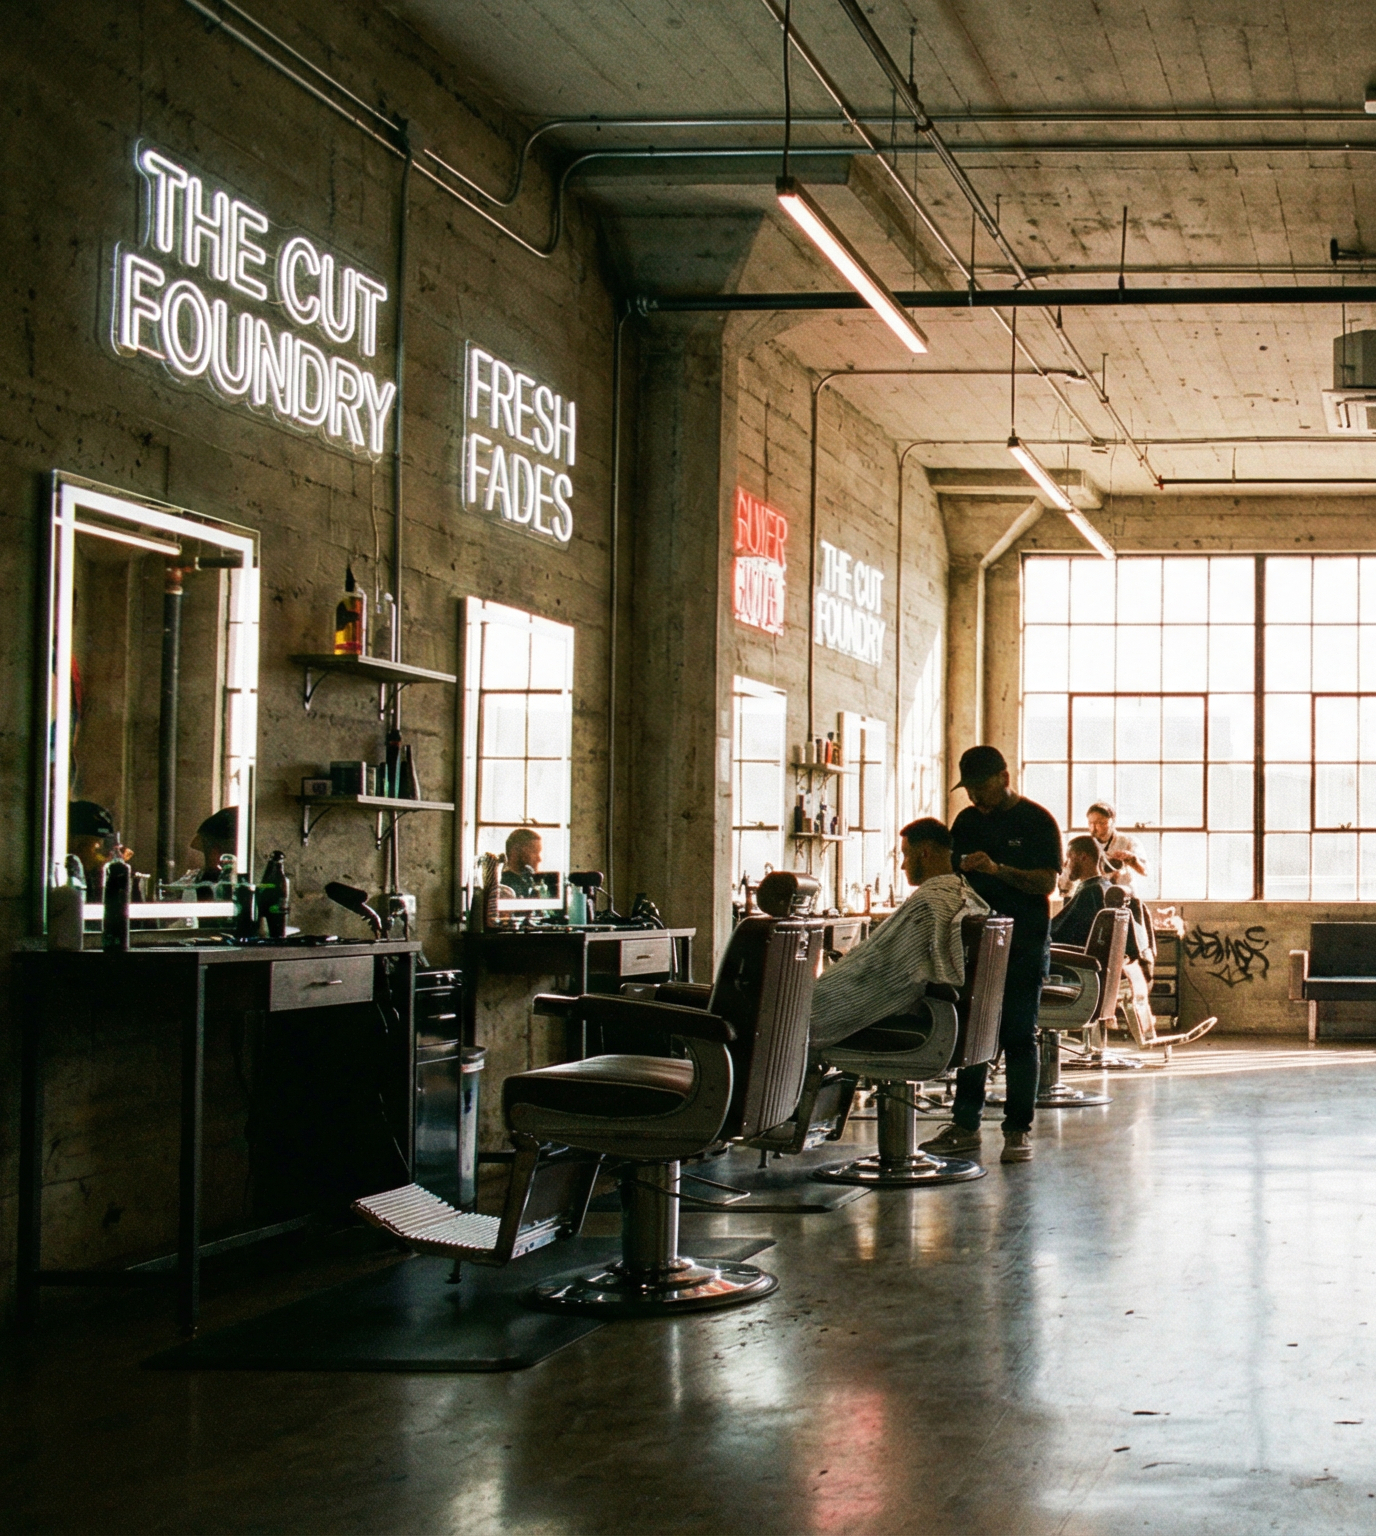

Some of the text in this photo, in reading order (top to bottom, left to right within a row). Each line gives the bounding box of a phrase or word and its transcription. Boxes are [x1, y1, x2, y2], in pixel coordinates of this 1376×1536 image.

[141, 149, 388, 357] THE CUT
[122, 253, 396, 456] FOUNDRY
[470, 346, 577, 467] FRESH
[467, 434, 574, 542] FADES
[814, 592, 887, 669] FOUNDRY
[820, 539, 853, 602] THE
[853, 560, 885, 615] CUT
